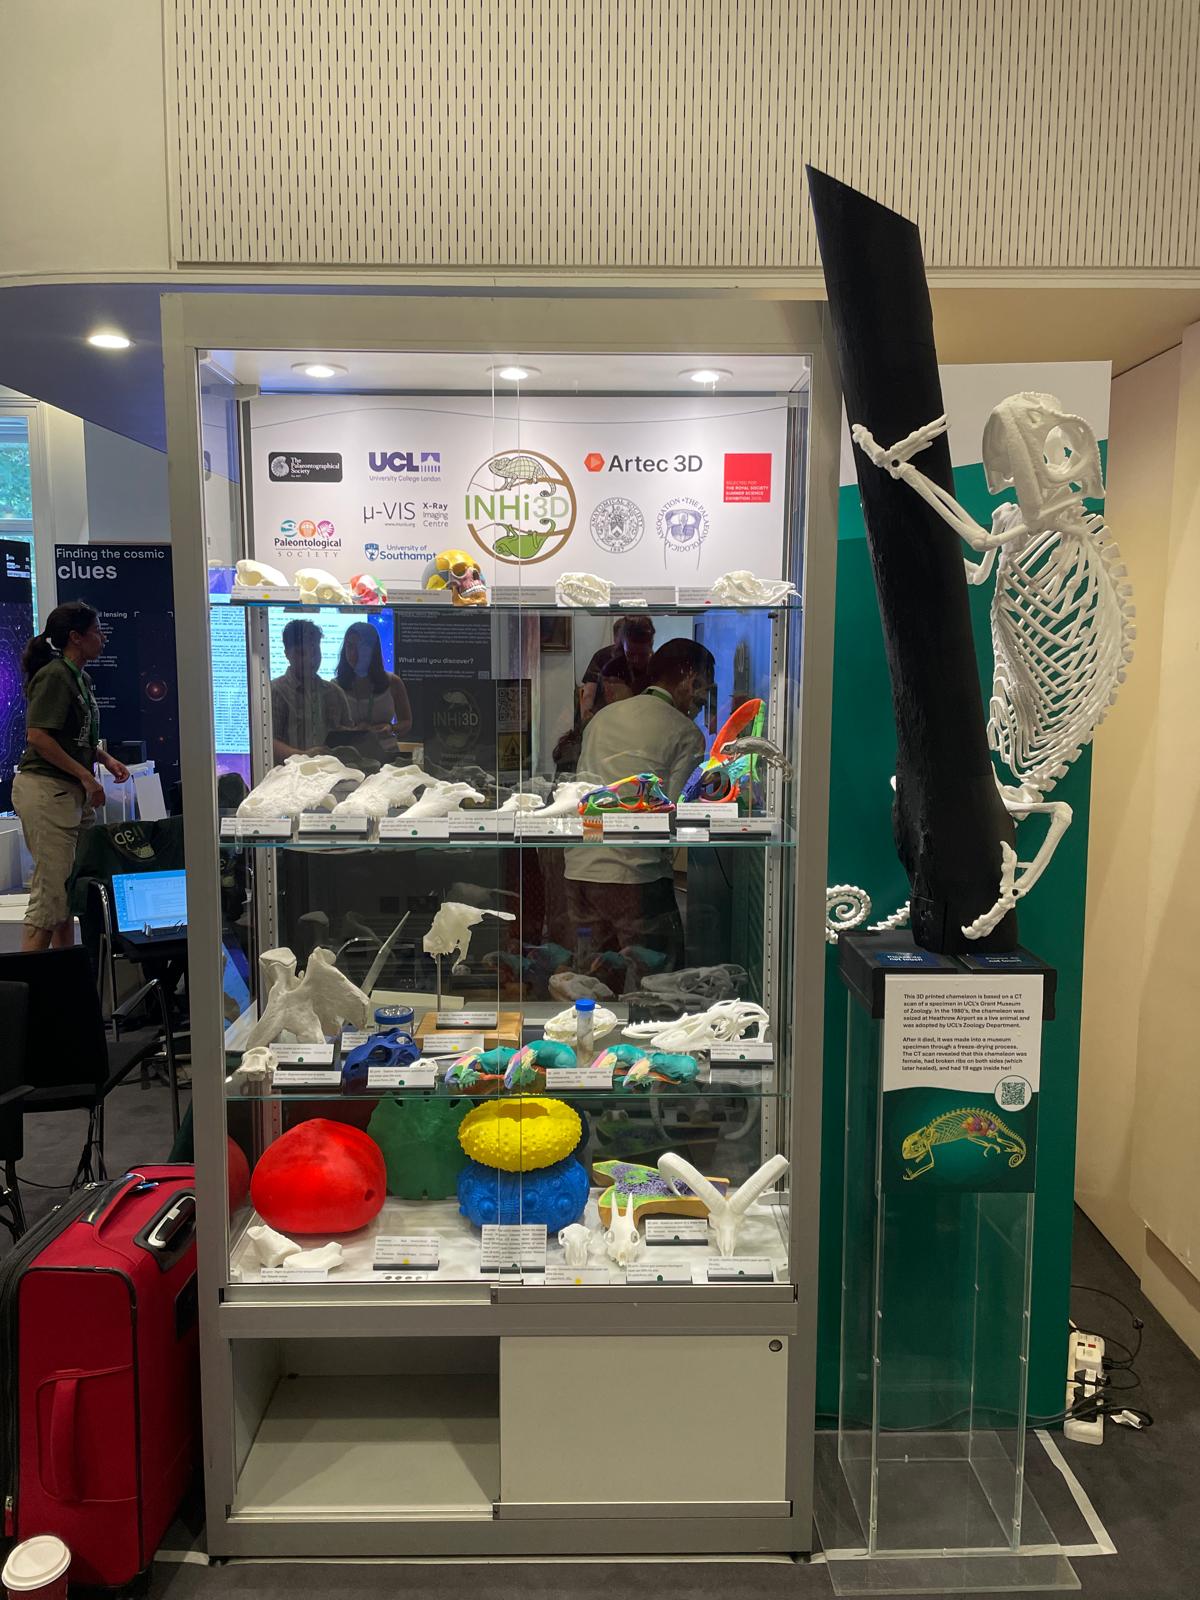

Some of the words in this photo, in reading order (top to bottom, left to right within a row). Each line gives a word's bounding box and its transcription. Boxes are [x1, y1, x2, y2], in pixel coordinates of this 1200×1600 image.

[290, 462, 340, 470] Palaeontographical
[368, 452, 419, 472] UCL
[608, 454, 668, 472] Artec
[674, 454, 702, 472] 3D
[422, 502, 448, 511] X-Ray
[464, 494, 569, 520] INHi3D
[684, 497, 698, 508] THE
[363, 502, 416, 524] μ-VIS
[422, 512, 448, 520] Imaging
[274, 538, 342, 548] Paleontological
[56, 548, 98, 560] Finding
[101, 548, 120, 558] the
[124, 549, 164, 558] cosmic
[380, 550, 436, 562] Southampt
[58, 561, 118, 579] clues
